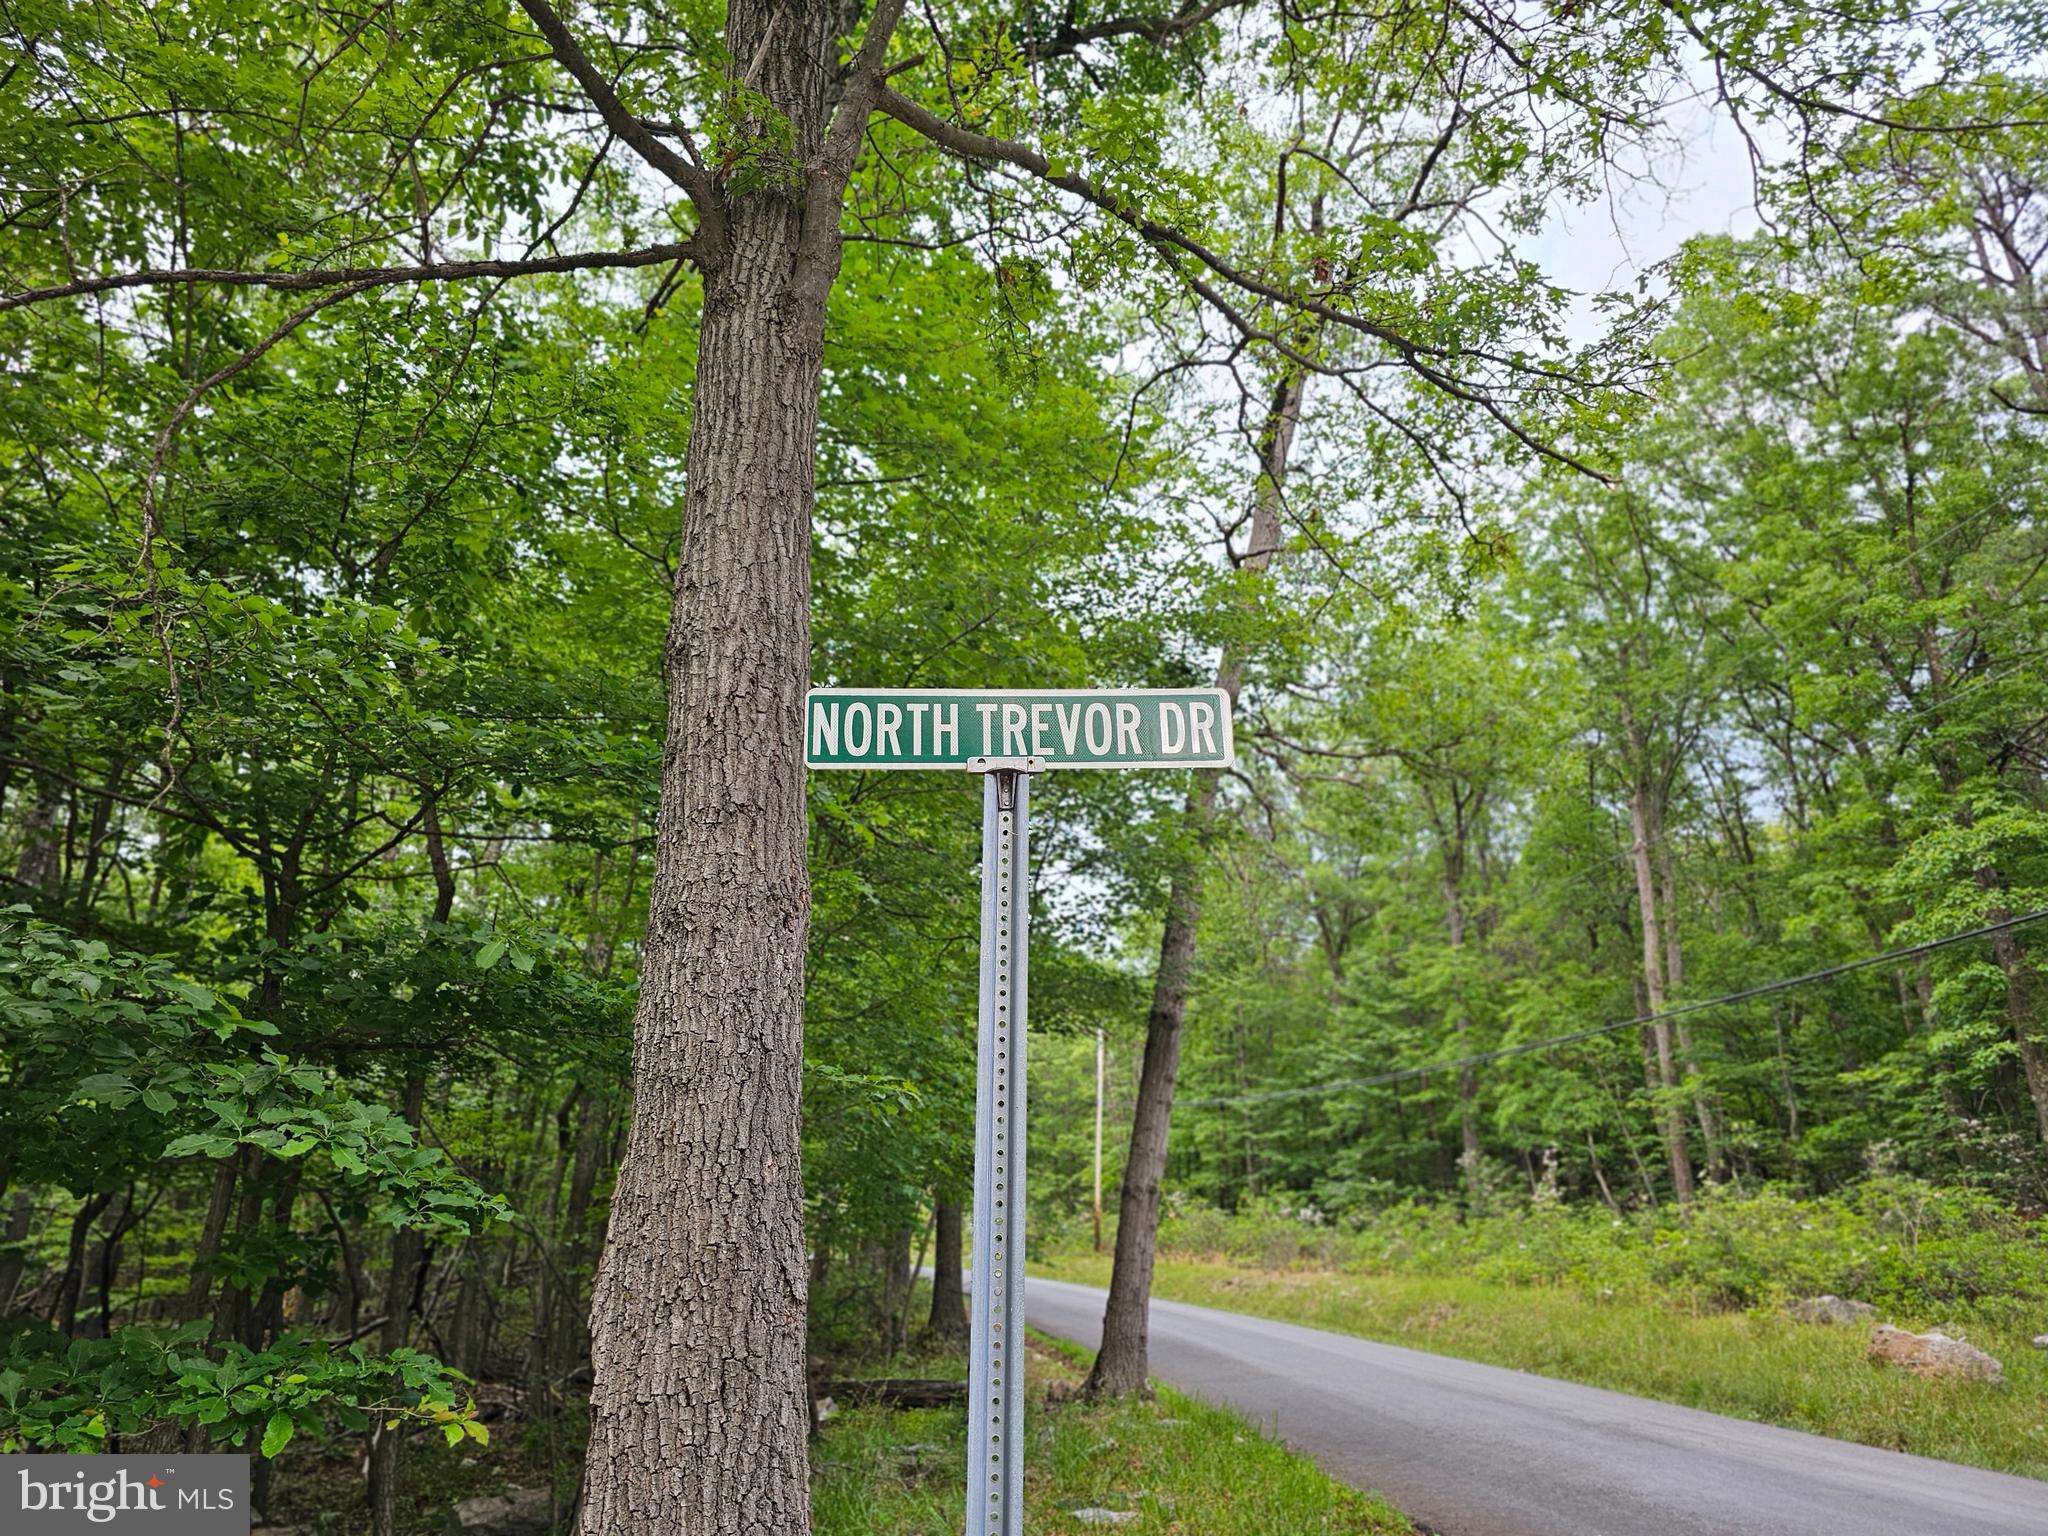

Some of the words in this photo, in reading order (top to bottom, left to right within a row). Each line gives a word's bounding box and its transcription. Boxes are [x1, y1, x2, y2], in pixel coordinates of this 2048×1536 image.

[812, 702, 959, 756] NORTH
[976, 702, 1142, 756] TREVOR
[1159, 702, 1217, 754] DR
